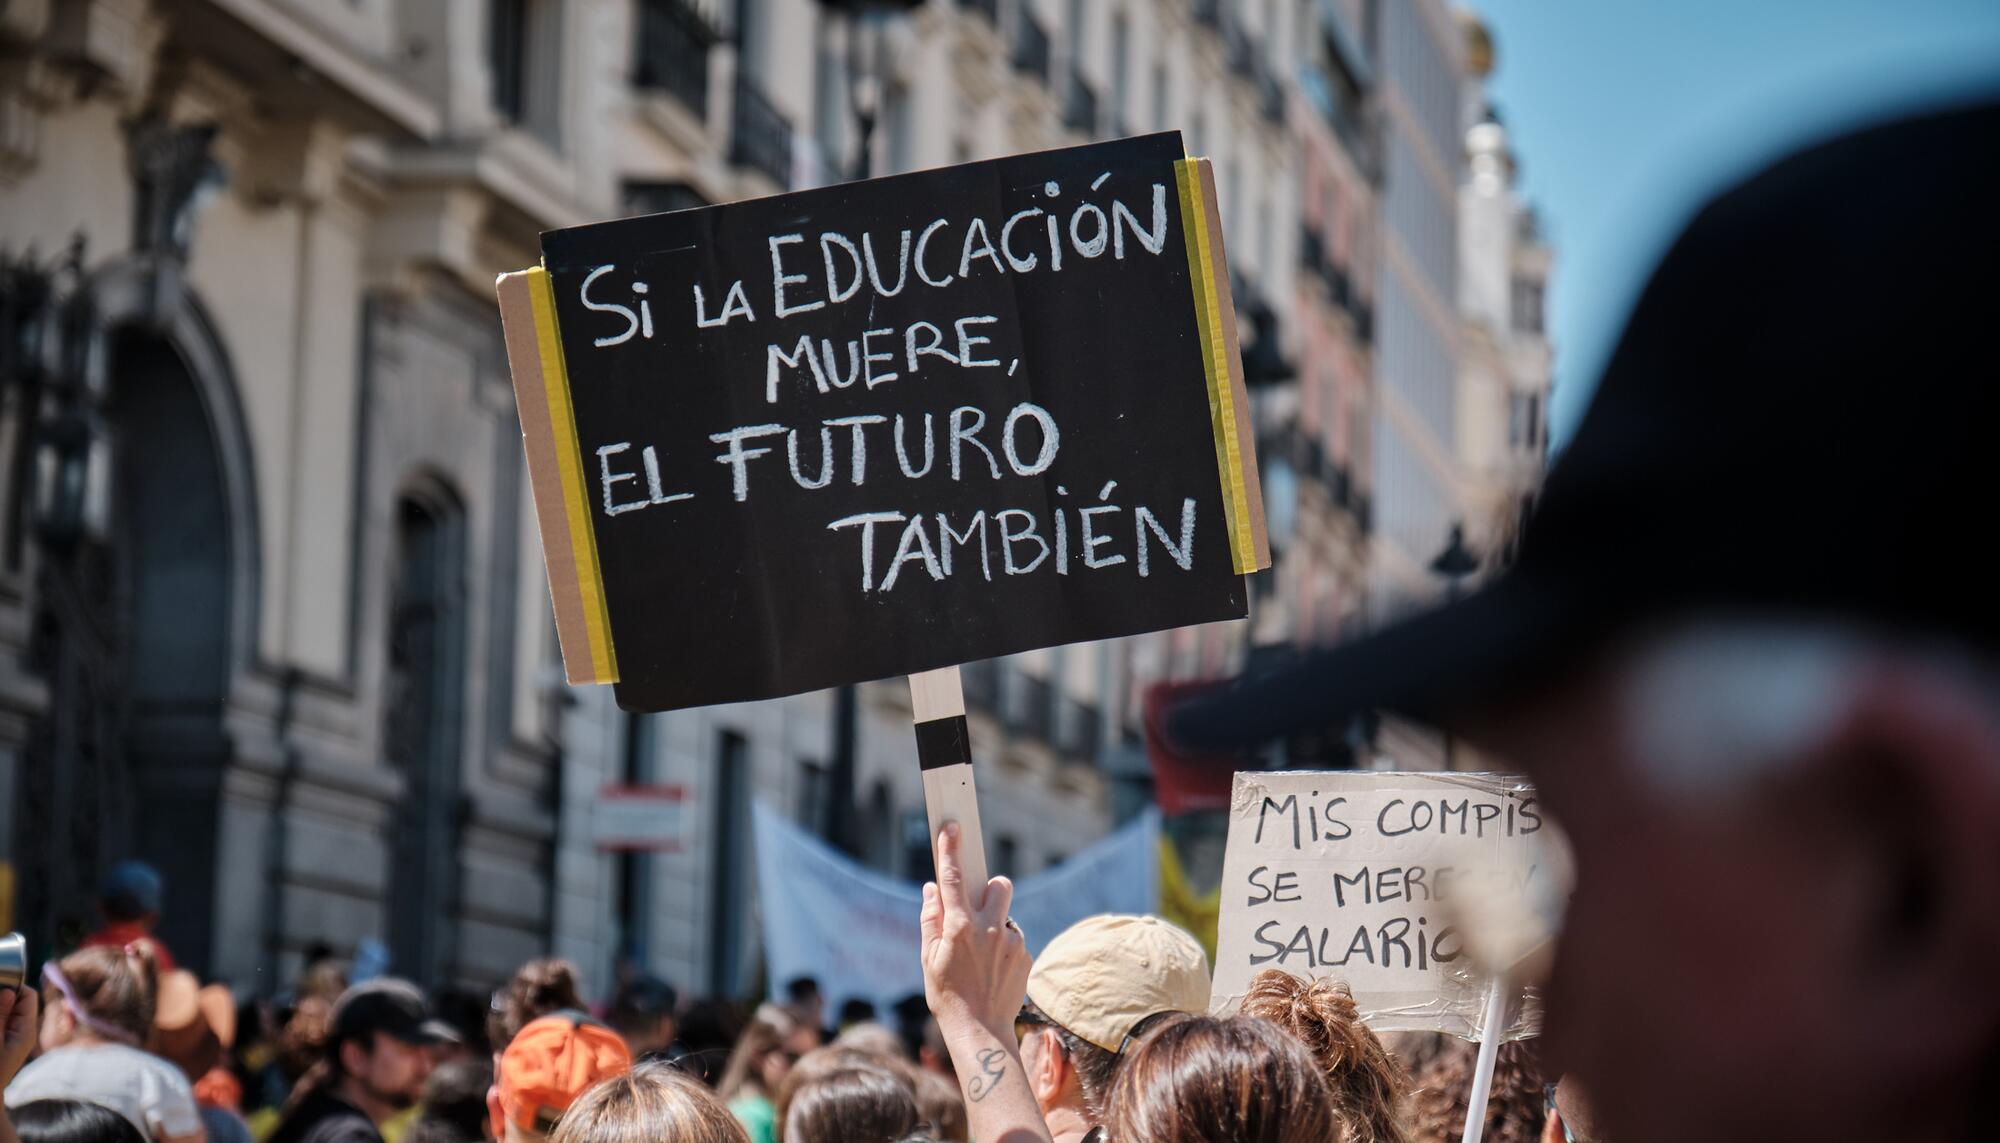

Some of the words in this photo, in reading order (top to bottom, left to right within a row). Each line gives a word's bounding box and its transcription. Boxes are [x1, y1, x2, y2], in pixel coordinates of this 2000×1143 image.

[694, 280, 756, 328] LA
[766, 315, 1020, 404] MUERE,
[596, 442, 695, 517] EL
[709, 402, 1060, 502] FUTURO
[1247, 866, 1302, 907] SE
